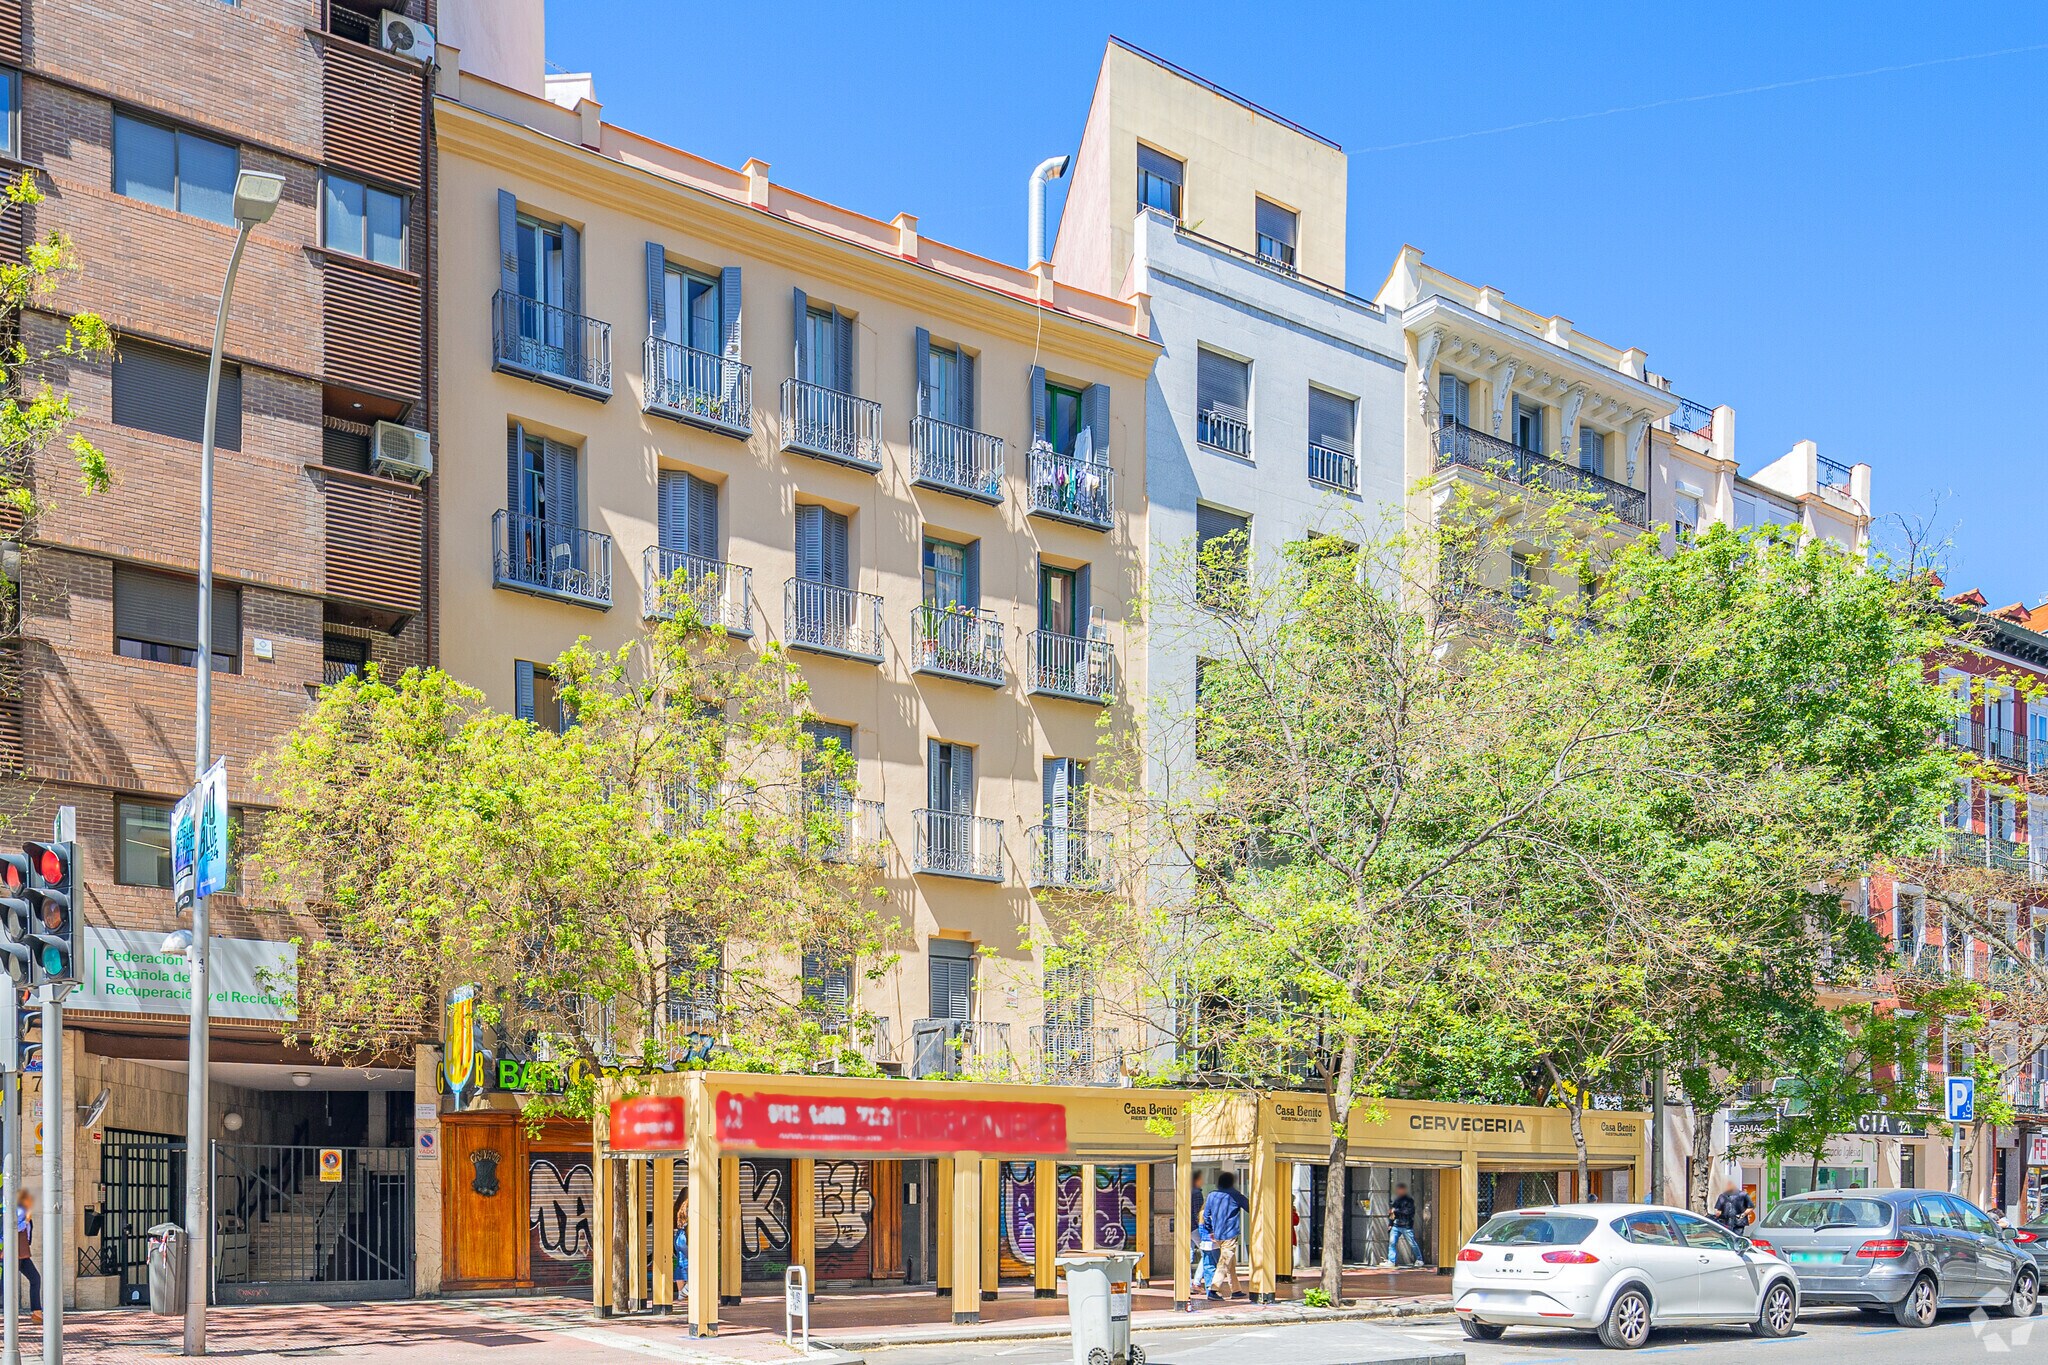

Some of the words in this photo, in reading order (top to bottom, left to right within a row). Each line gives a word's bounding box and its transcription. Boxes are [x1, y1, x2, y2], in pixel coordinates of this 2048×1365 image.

[106, 949, 183, 966] Federación
[106, 966, 169, 983] Española
[173, 970, 191, 983] de
[106, 983, 192, 1000] Recuperació
[216, 991, 228, 1002] el
[231, 991, 284, 1007] Reciclaj
[1952, 1083, 1968, 1117] P
[1124, 1103, 1146, 1115] Casa
[1149, 1103, 1178, 1116] Benito
[1275, 1104, 1295, 1116] Casa
[1297, 1105, 1322, 1117] Benito
[1409, 1115, 1526, 1133] CERVECERIA
[1600, 1121, 1616, 1131] Casa
[1617, 1121, 1637, 1133] Benito
[1729, 1123, 1777, 1133] FARMACA
